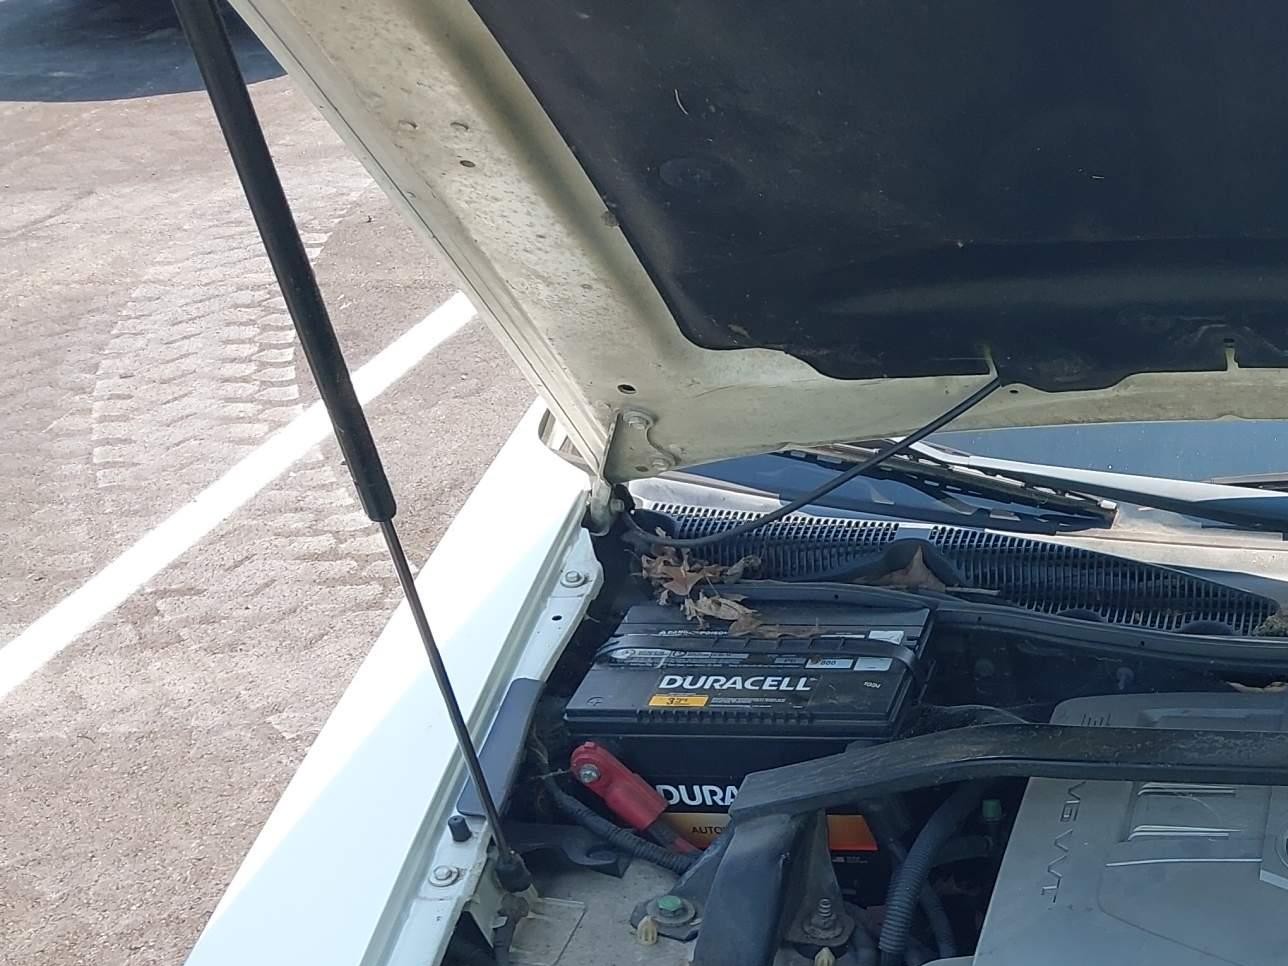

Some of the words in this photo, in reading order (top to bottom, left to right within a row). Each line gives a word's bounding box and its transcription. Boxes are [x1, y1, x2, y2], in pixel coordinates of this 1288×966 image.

[658, 675, 812, 691] DURACELL
[1060, 781, 1087, 822] V6
[1041, 828, 1074, 903] VVT
